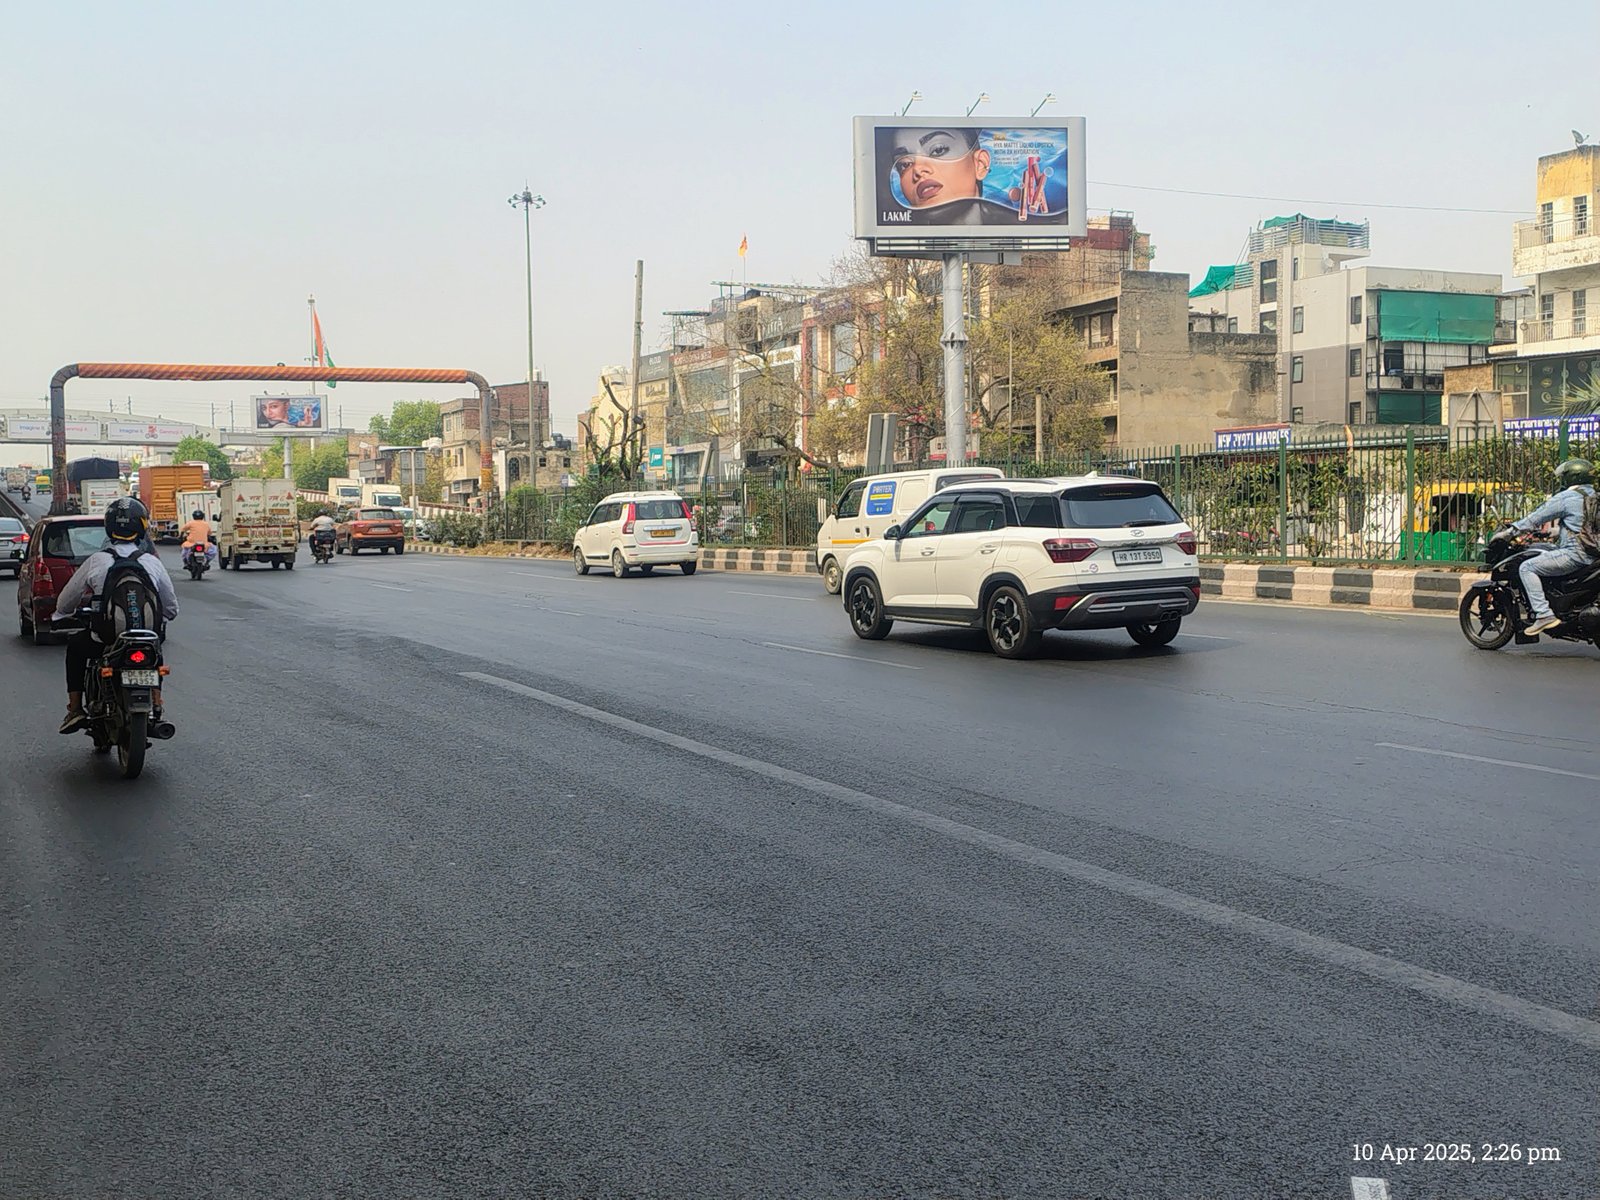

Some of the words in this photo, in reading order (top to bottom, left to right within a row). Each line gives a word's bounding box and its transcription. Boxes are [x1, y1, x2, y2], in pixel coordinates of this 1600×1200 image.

[1217, 433, 1232, 449] NEW
[724, 462, 746, 481] Vitr
[872, 485, 893, 494] PORTER
[1119, 553, 1128, 562] HR
